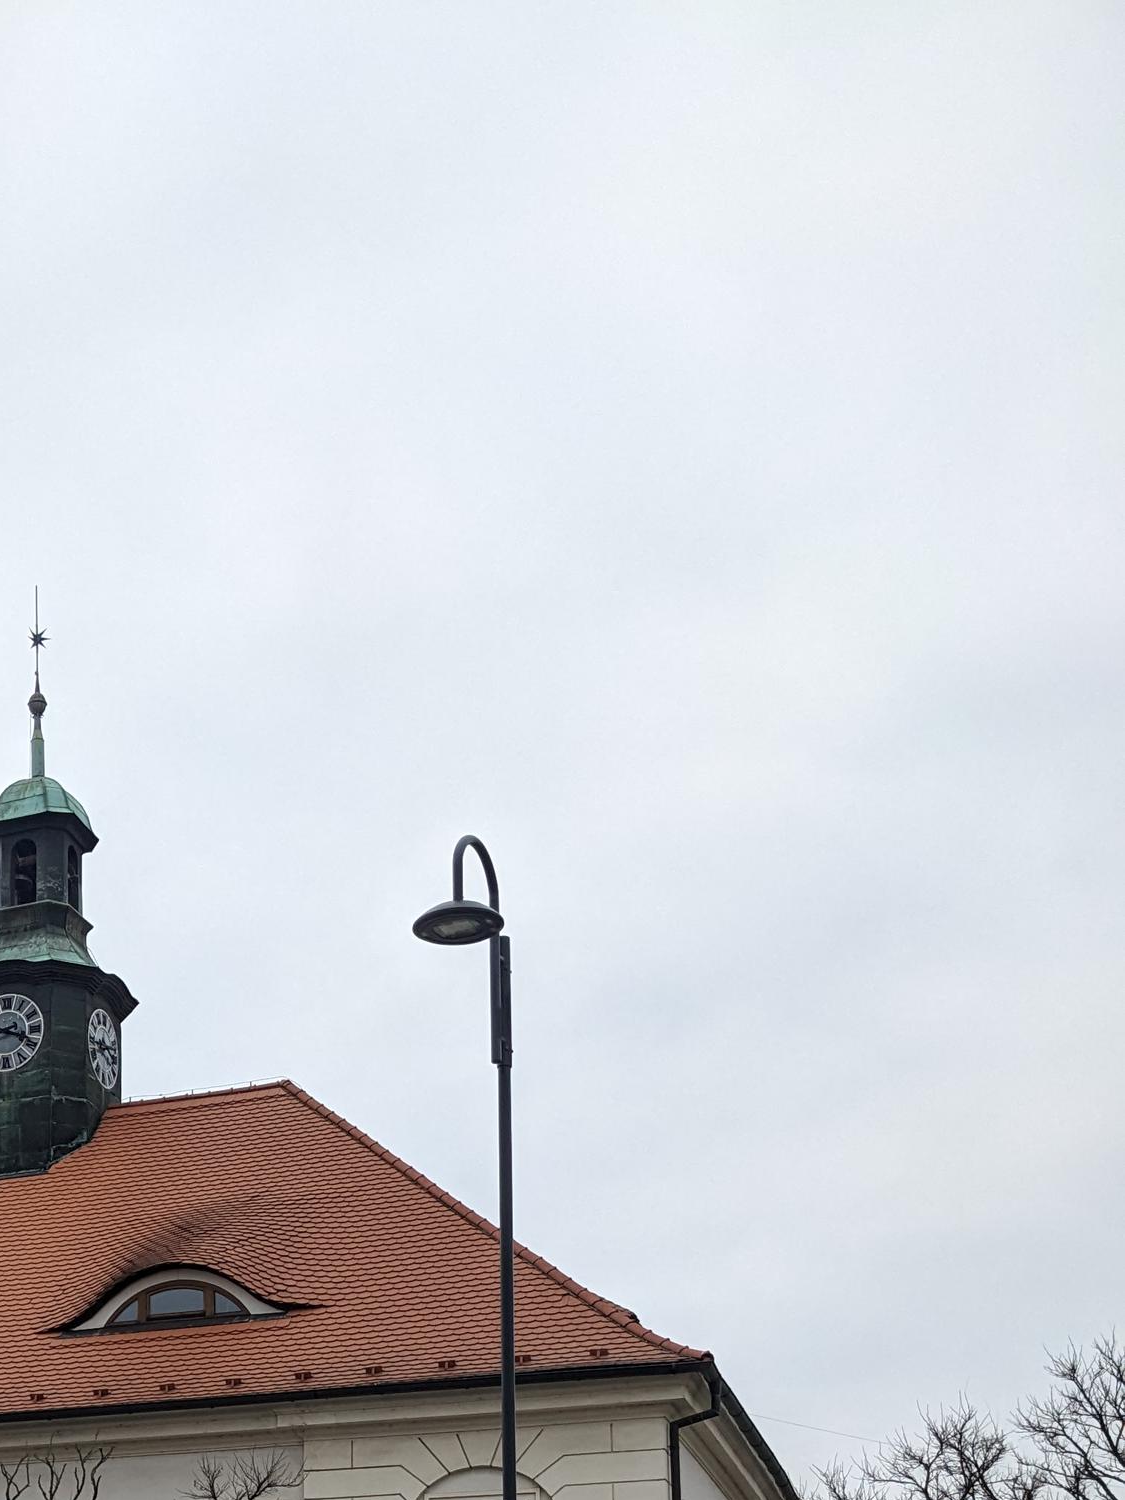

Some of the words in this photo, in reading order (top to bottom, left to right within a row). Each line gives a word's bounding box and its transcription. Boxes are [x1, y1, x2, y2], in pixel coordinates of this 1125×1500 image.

[17, 1000, 26, 1011] I
[25, 1009, 37, 1020] II
[30, 1024, 40, 1035] III
[2, 1056, 11, 1069] VI
[17, 1052, 28, 1064] V
